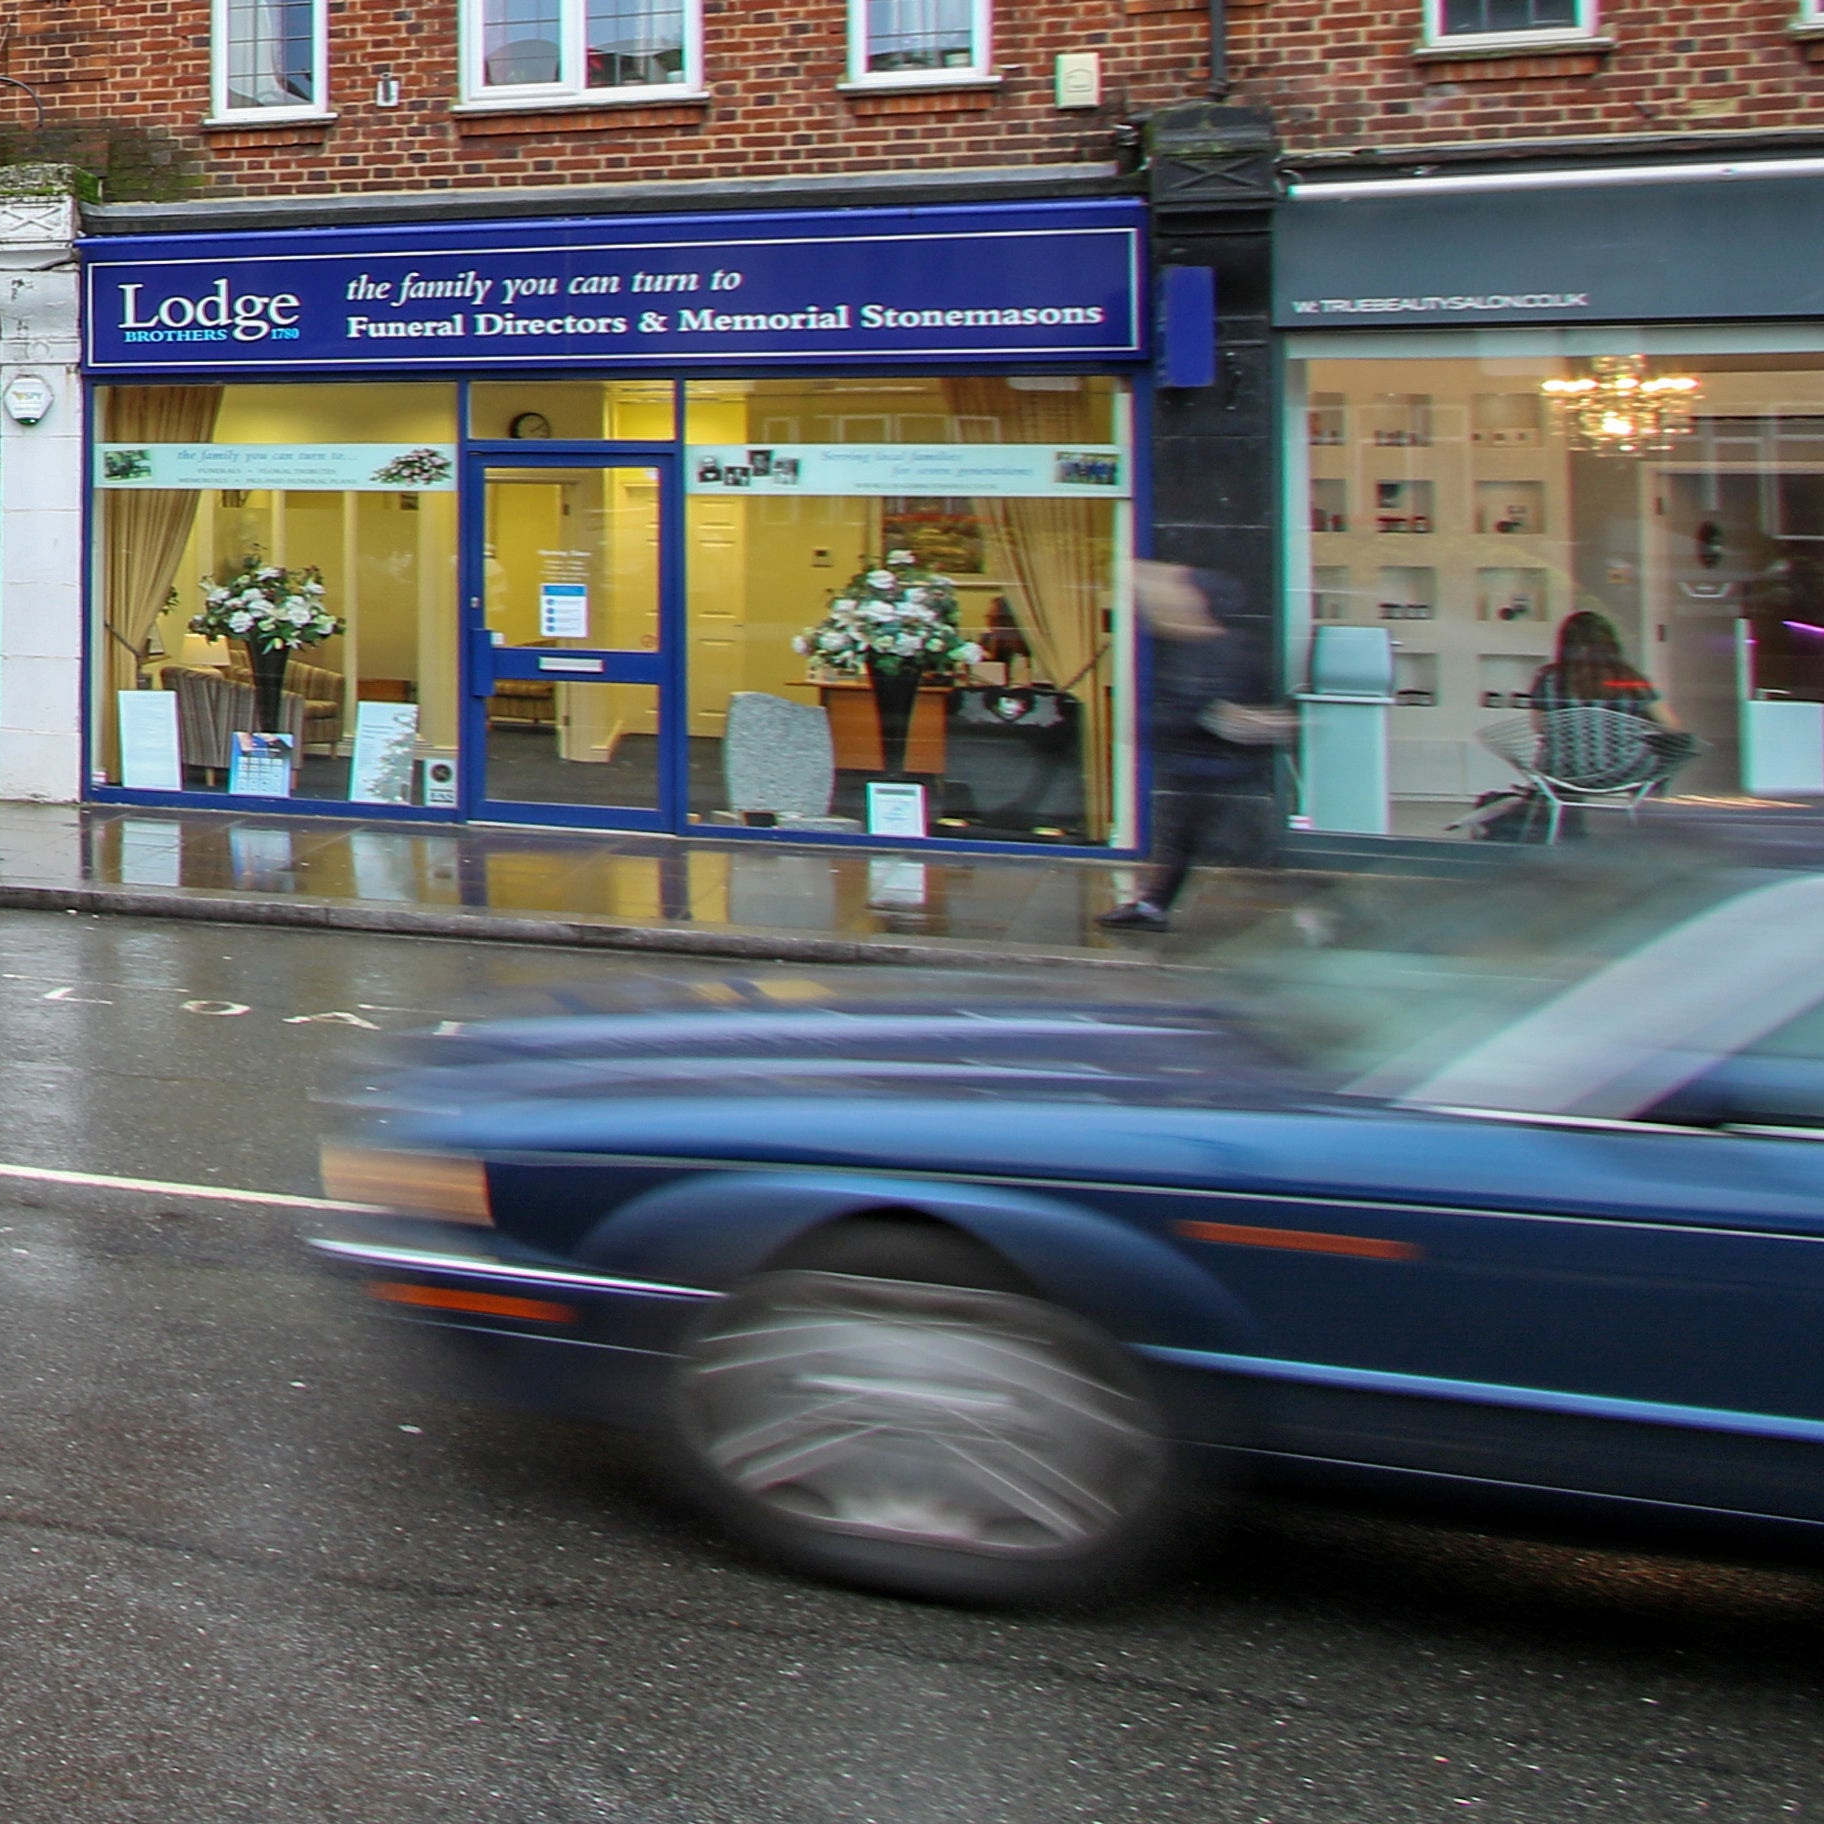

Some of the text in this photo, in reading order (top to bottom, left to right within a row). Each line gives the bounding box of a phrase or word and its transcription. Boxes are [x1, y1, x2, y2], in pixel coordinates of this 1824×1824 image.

[346, 268, 742, 307] the family you can turn to
[118, 279, 301, 342] Lodge
[346, 303, 1104, 339] Funeral Directors & Memorial Stonemasons
[124, 328, 228, 343] BROTHERS
[270, 327, 300, 341] 1780
[176, 450, 195, 461] the
[196, 449, 240, 463] family
[243, 452, 268, 463] you
[271, 452, 293, 461] can
[297, 451, 326, 461] turn
